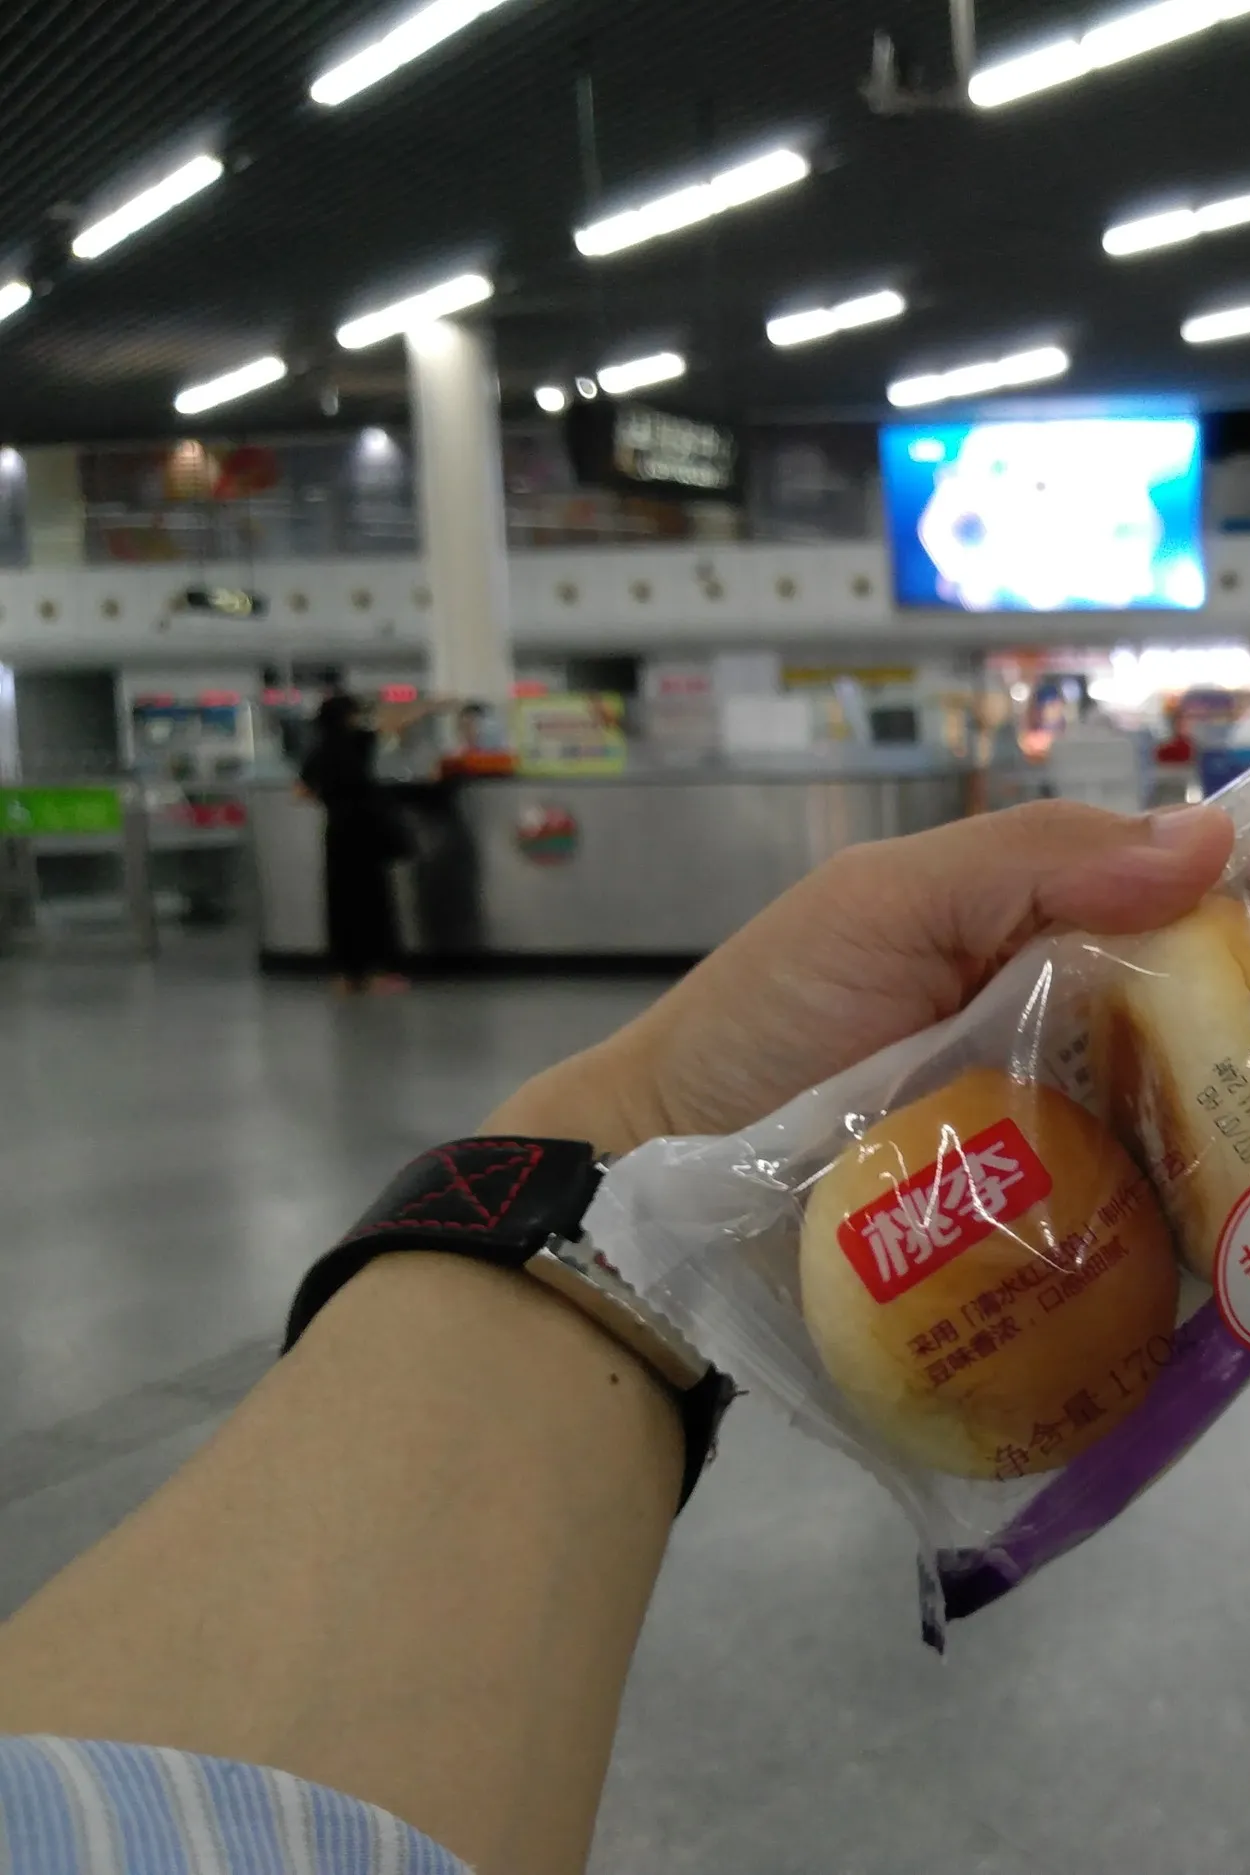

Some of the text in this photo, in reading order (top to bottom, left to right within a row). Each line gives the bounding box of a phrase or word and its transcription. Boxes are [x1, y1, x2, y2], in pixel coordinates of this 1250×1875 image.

[861, 1141, 1024, 1283] 桃李
[986, 1387, 1107, 1483] 净含量
